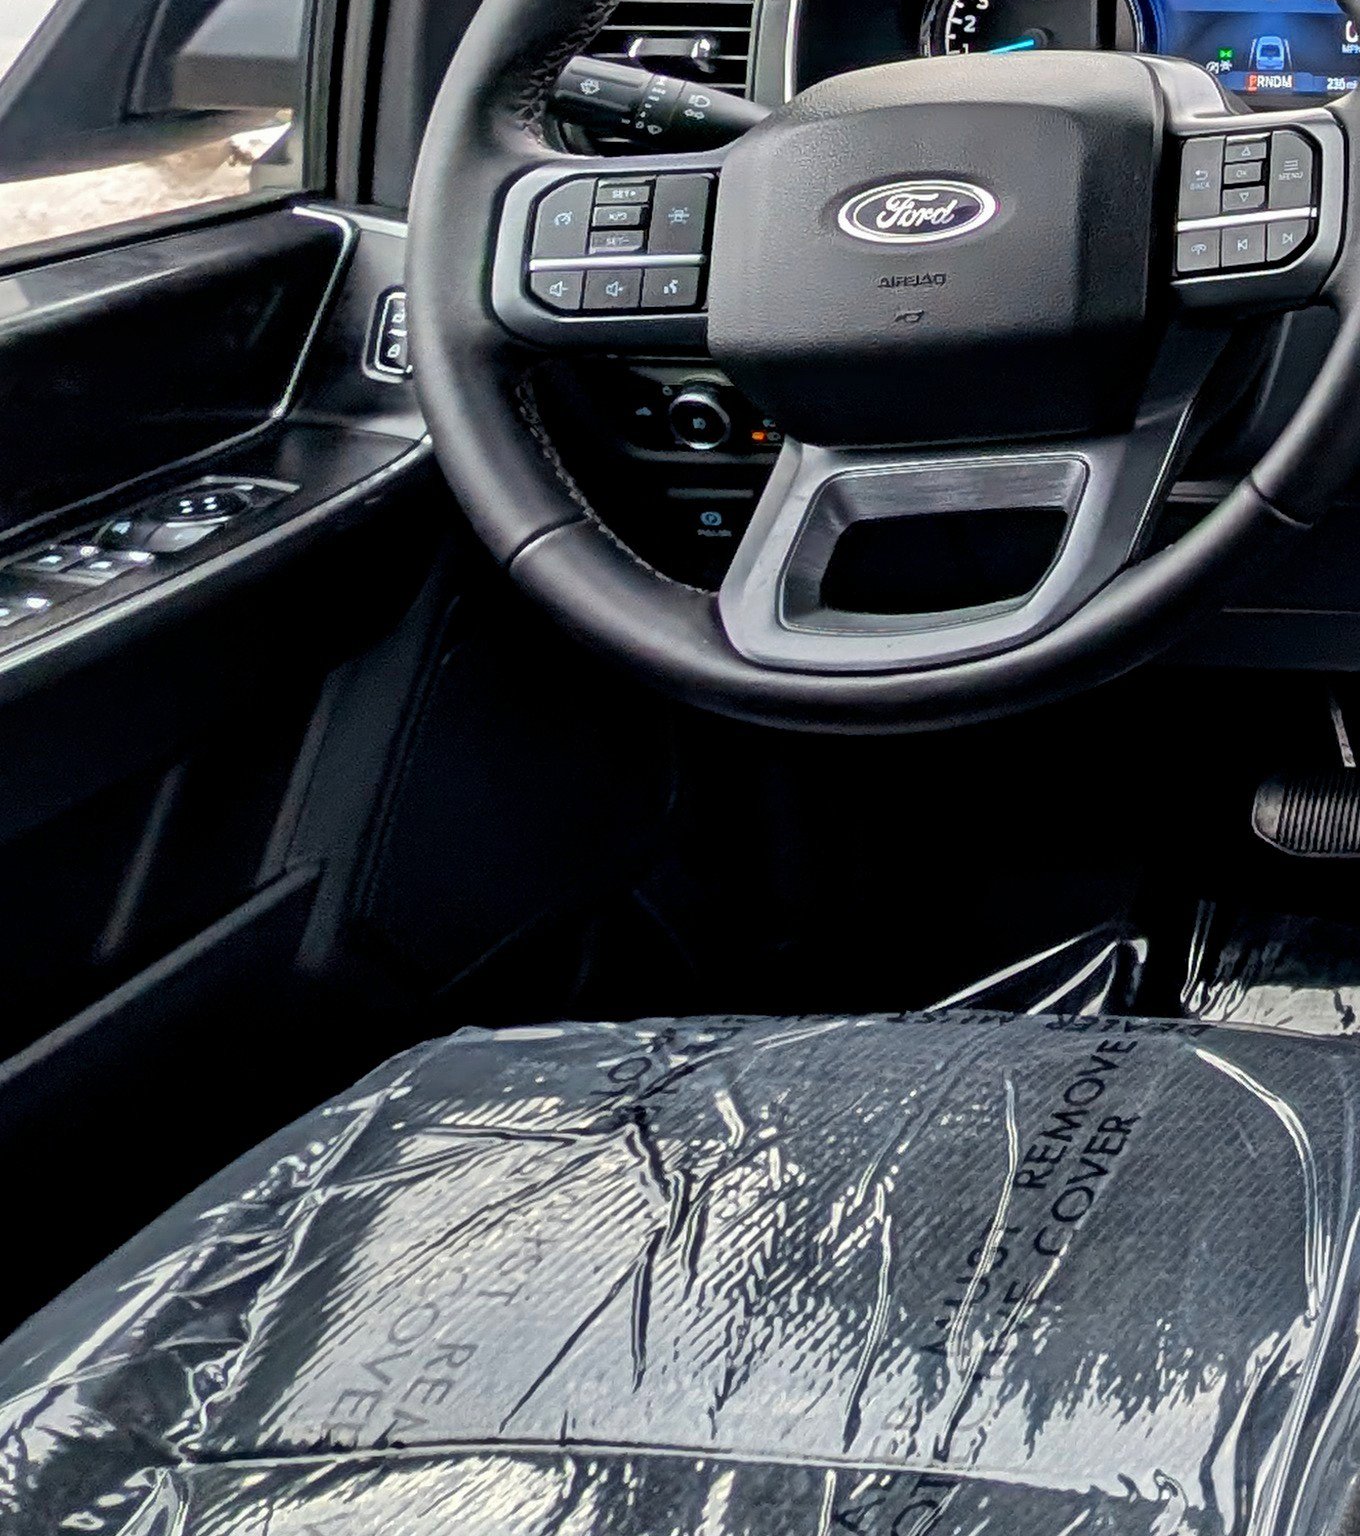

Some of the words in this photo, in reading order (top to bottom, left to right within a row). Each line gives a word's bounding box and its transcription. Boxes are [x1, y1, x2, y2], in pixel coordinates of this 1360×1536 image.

[964, 15, 976, 33] 2
[1278, 170, 1303, 182] MENU
[876, 192, 956, 233] Ford
[1013, 1039, 1139, 1189] REMOVE
[1033, 1114, 1142, 1256] COVER
